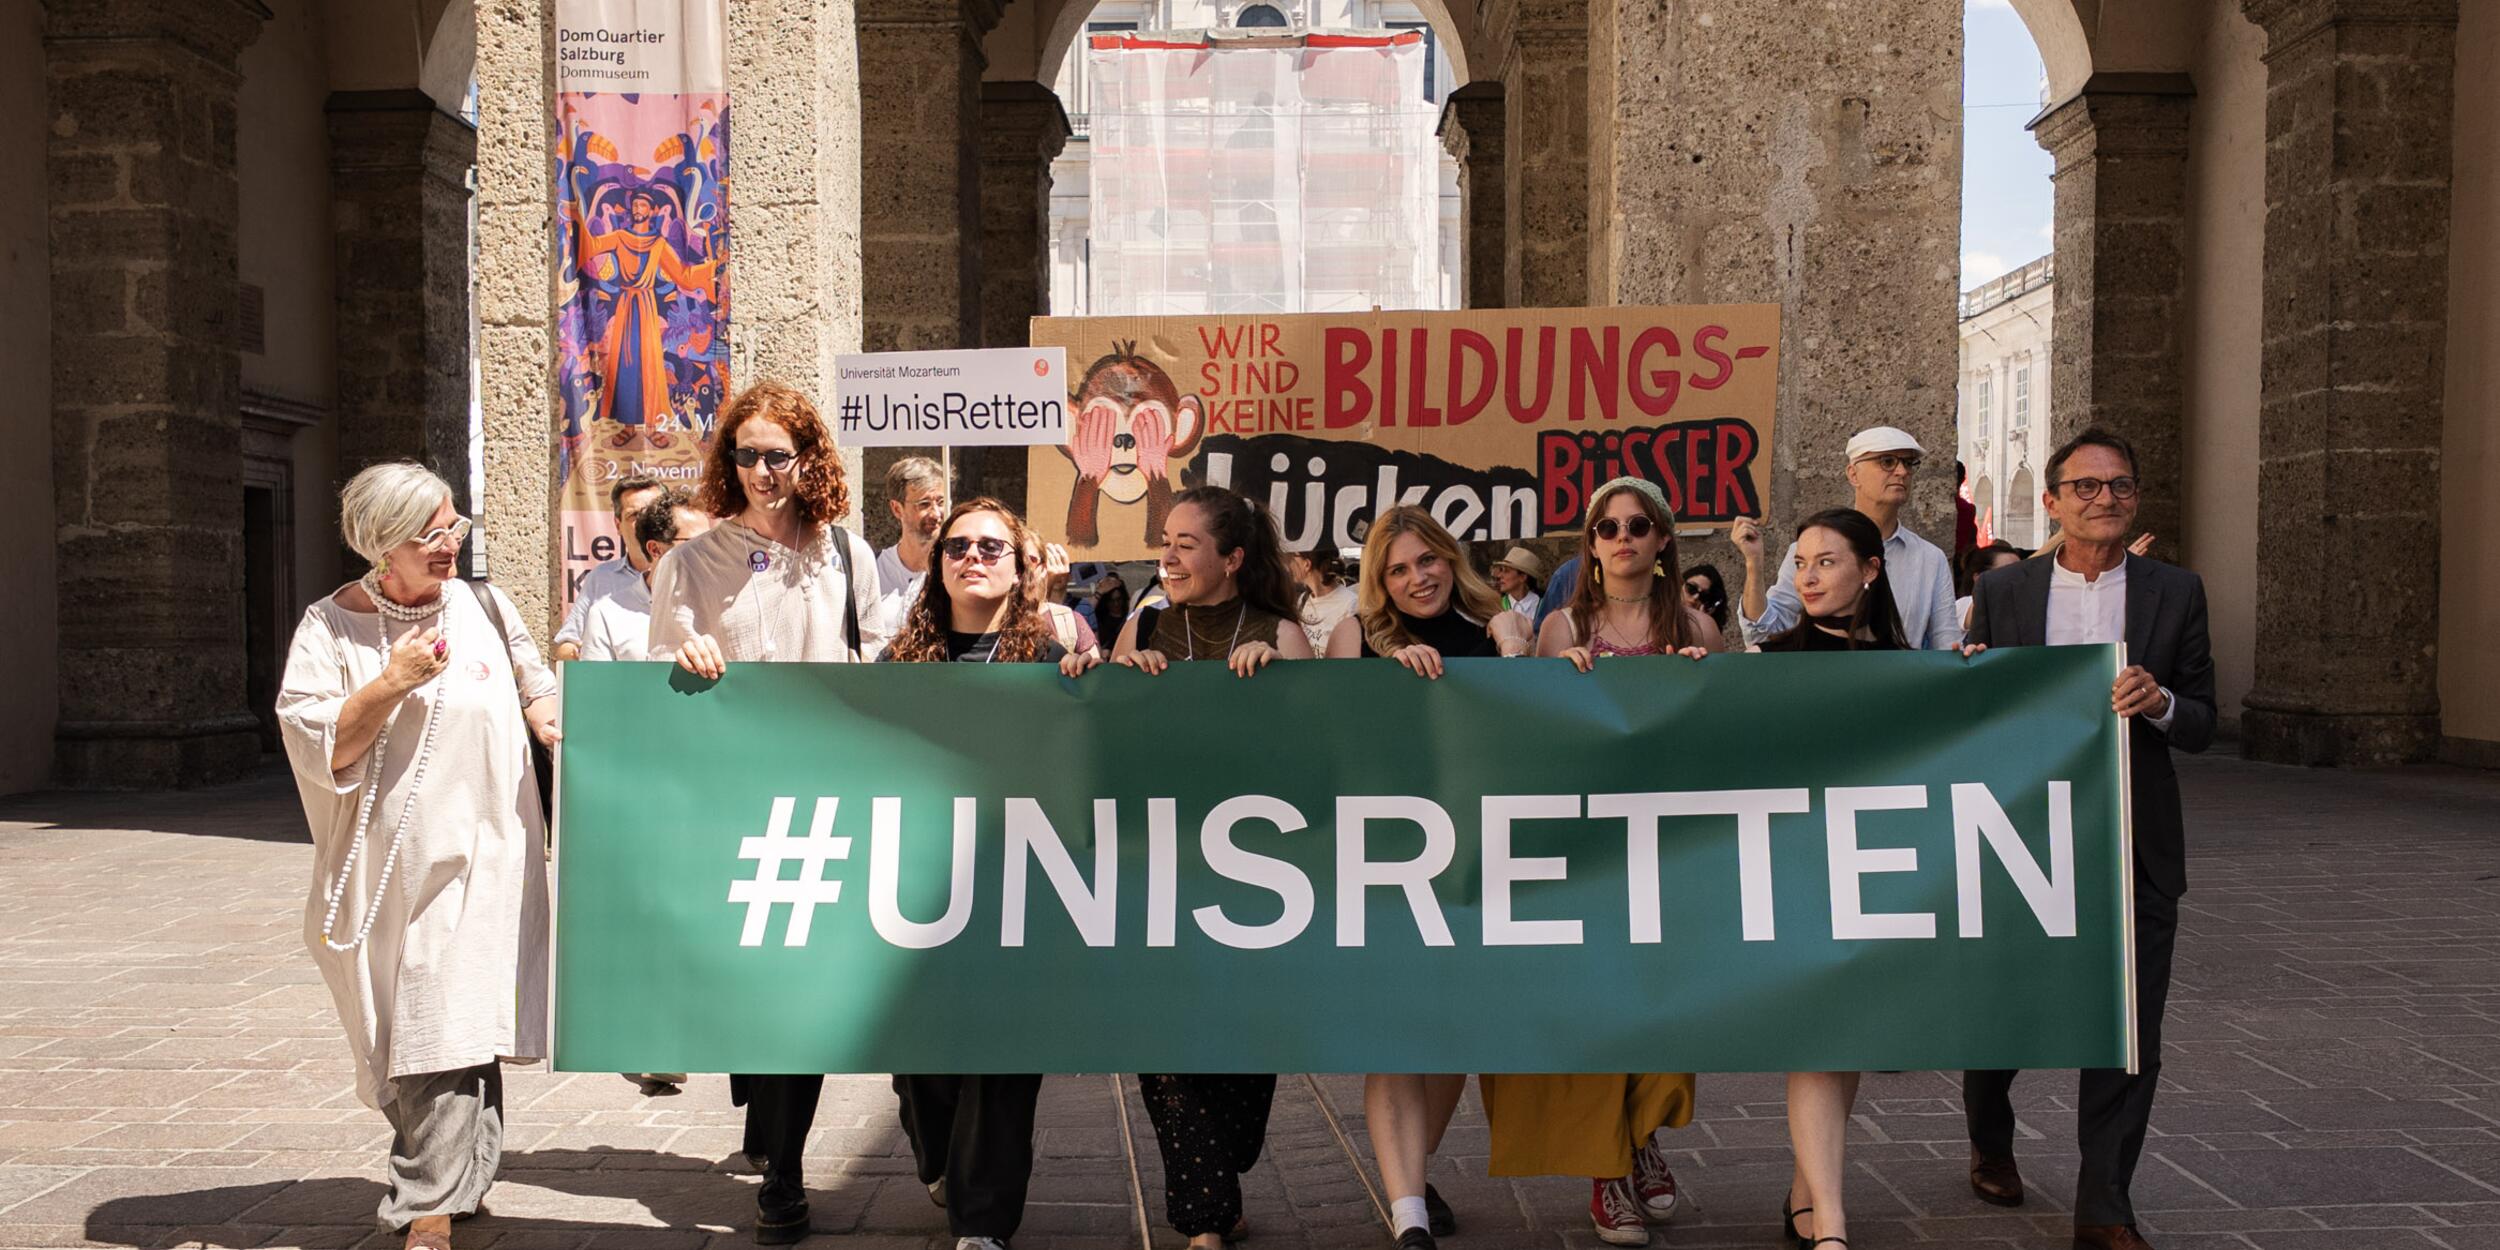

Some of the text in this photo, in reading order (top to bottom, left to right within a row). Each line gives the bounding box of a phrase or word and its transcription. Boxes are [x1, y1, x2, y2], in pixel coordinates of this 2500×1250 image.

[560, 47, 625, 65] Salzburg
[560, 65, 649, 79] Dommuseum
[1198, 324, 1285, 359] WIR
[841, 365, 960, 380] Universität Mozarteum
[1200, 361, 1299, 396] SIND
[1324, 325, 1769, 429] BILDUNGS-
[840, 392, 1063, 431] #UnisRetten
[1208, 398, 1314, 433] KEINE
[605, 460, 624, 480] 2.
[727, 780, 2077, 949] #UNISRETTEN
